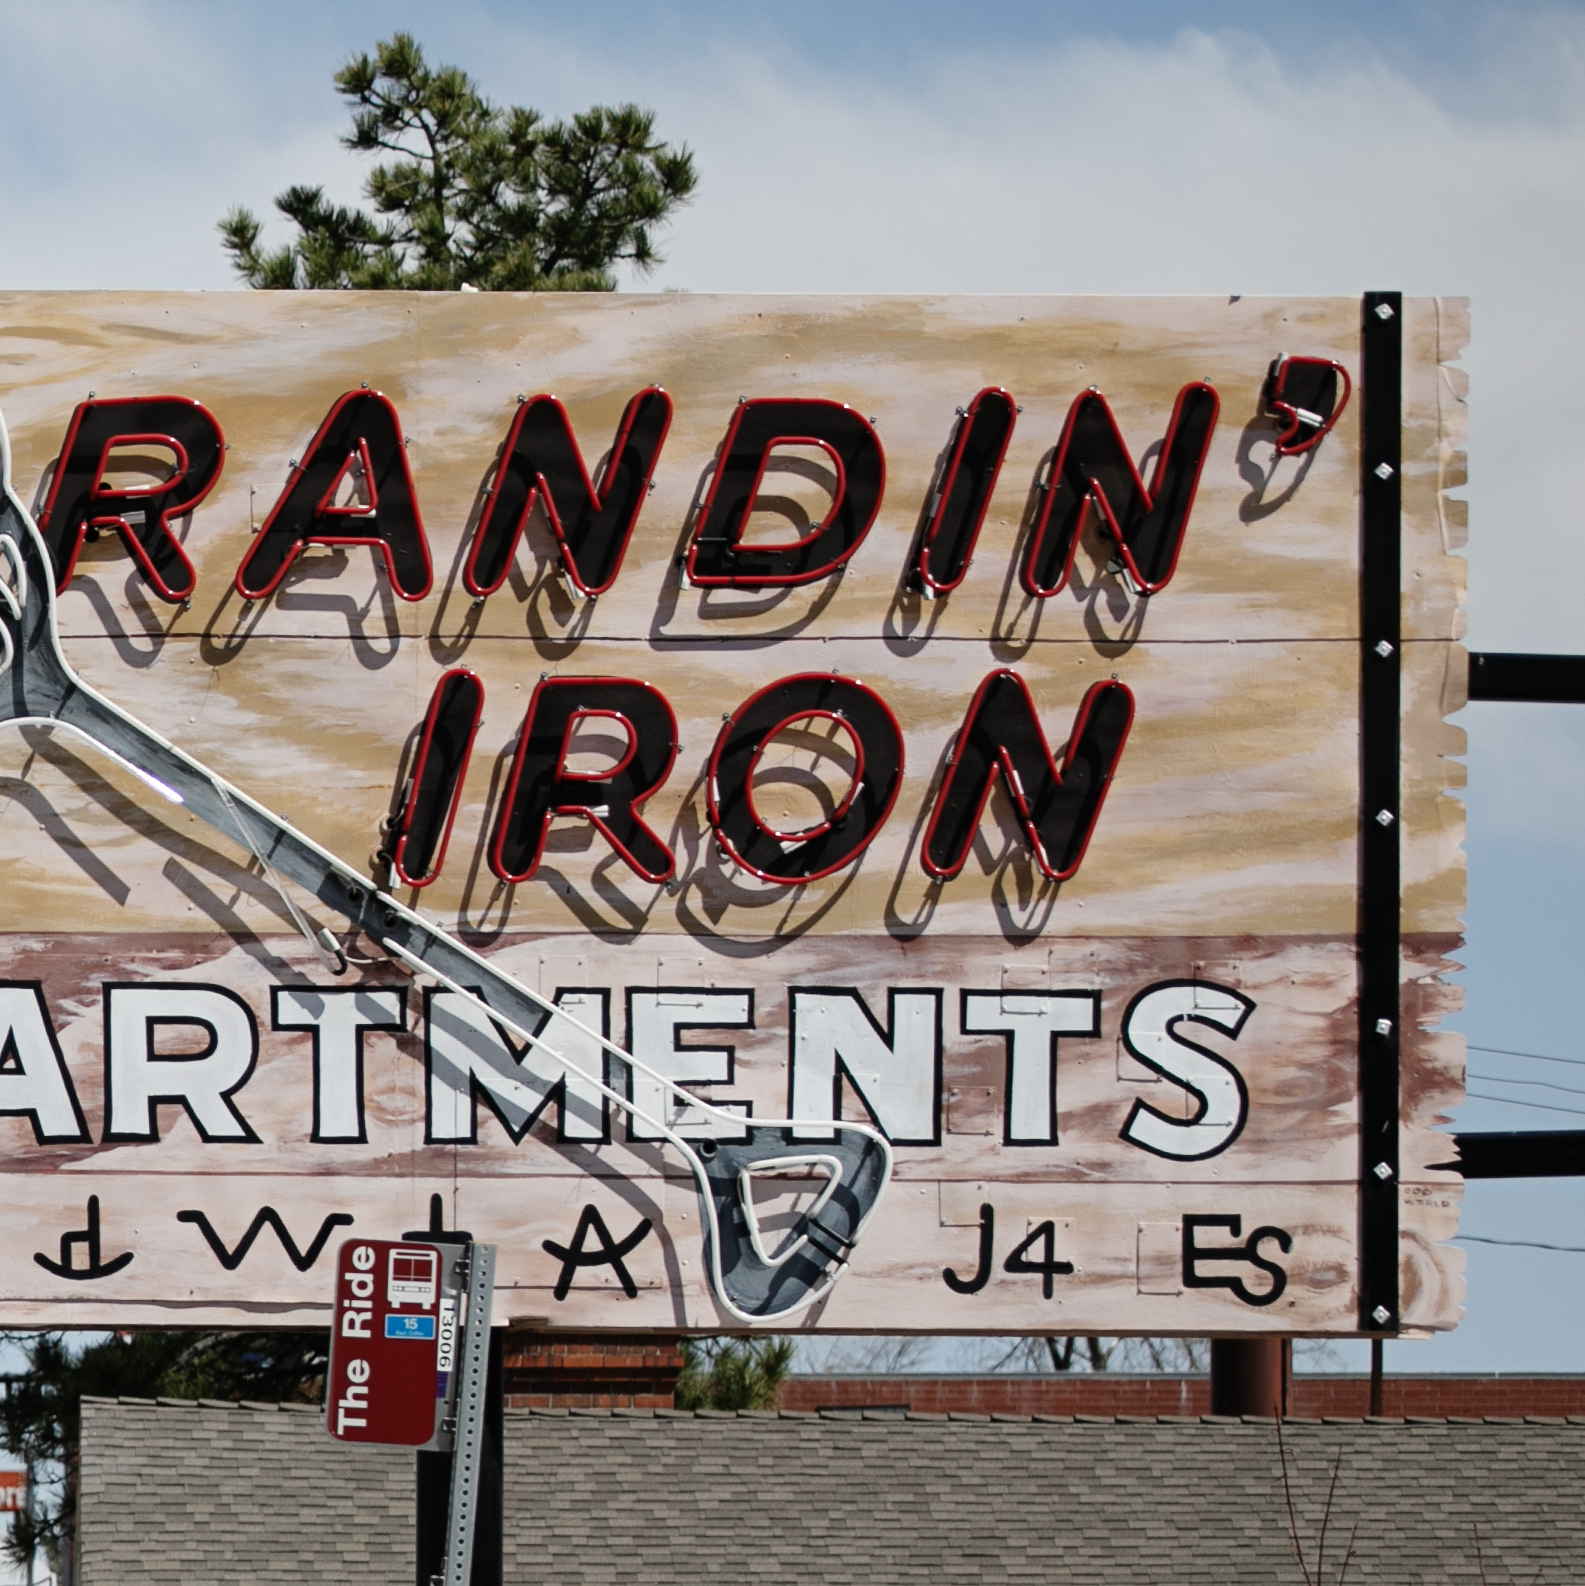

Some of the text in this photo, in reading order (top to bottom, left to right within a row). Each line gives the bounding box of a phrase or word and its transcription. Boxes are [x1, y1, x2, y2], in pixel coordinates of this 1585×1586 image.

[394, 664, 1135, 888] IRON
[337, 1245, 377, 1436] The Ride
[403, 1318, 419, 1330] 15
[440, 1306, 456, 1368] 13006
